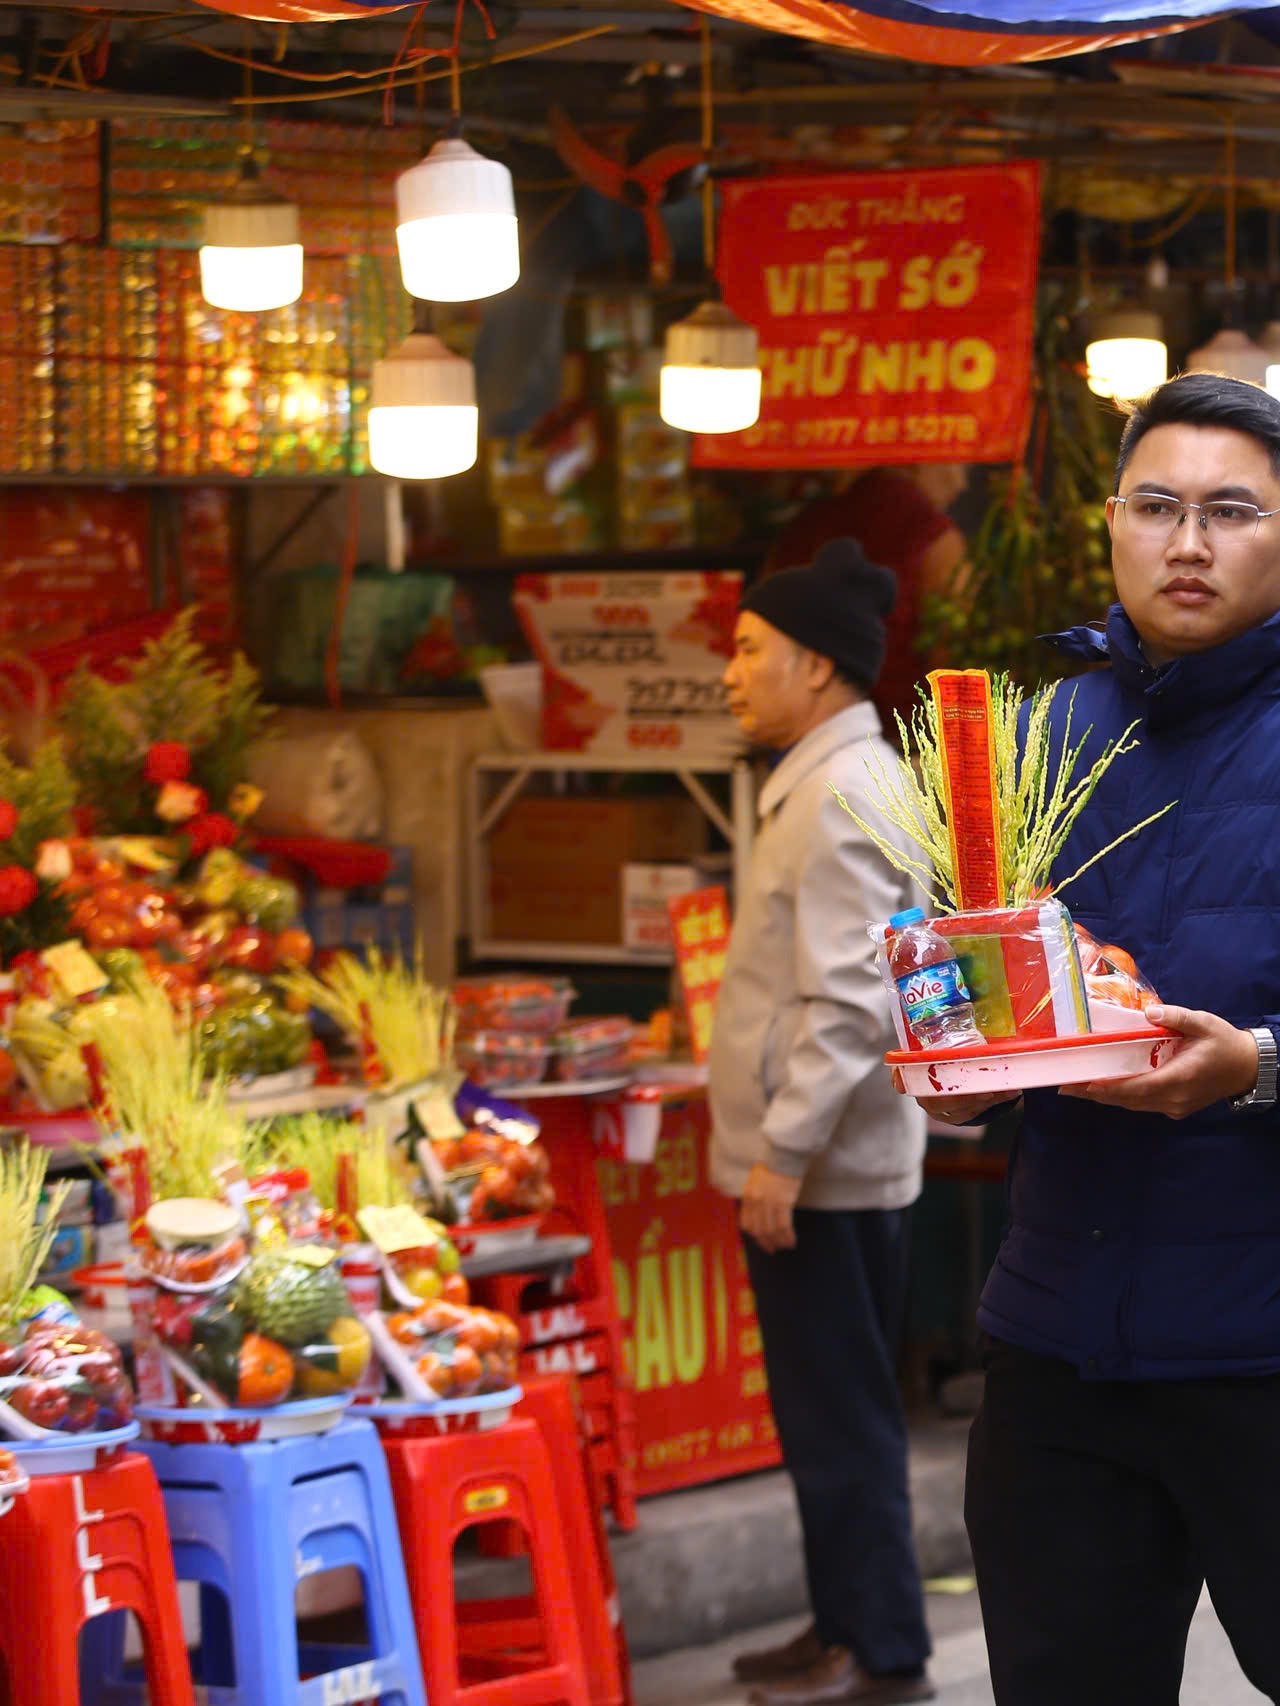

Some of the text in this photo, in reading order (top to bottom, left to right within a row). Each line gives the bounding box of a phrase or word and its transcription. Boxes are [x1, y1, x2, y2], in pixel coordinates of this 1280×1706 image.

[763, 238, 986, 316] VIẾT SỚ
[858, 337, 997, 395] NHO
